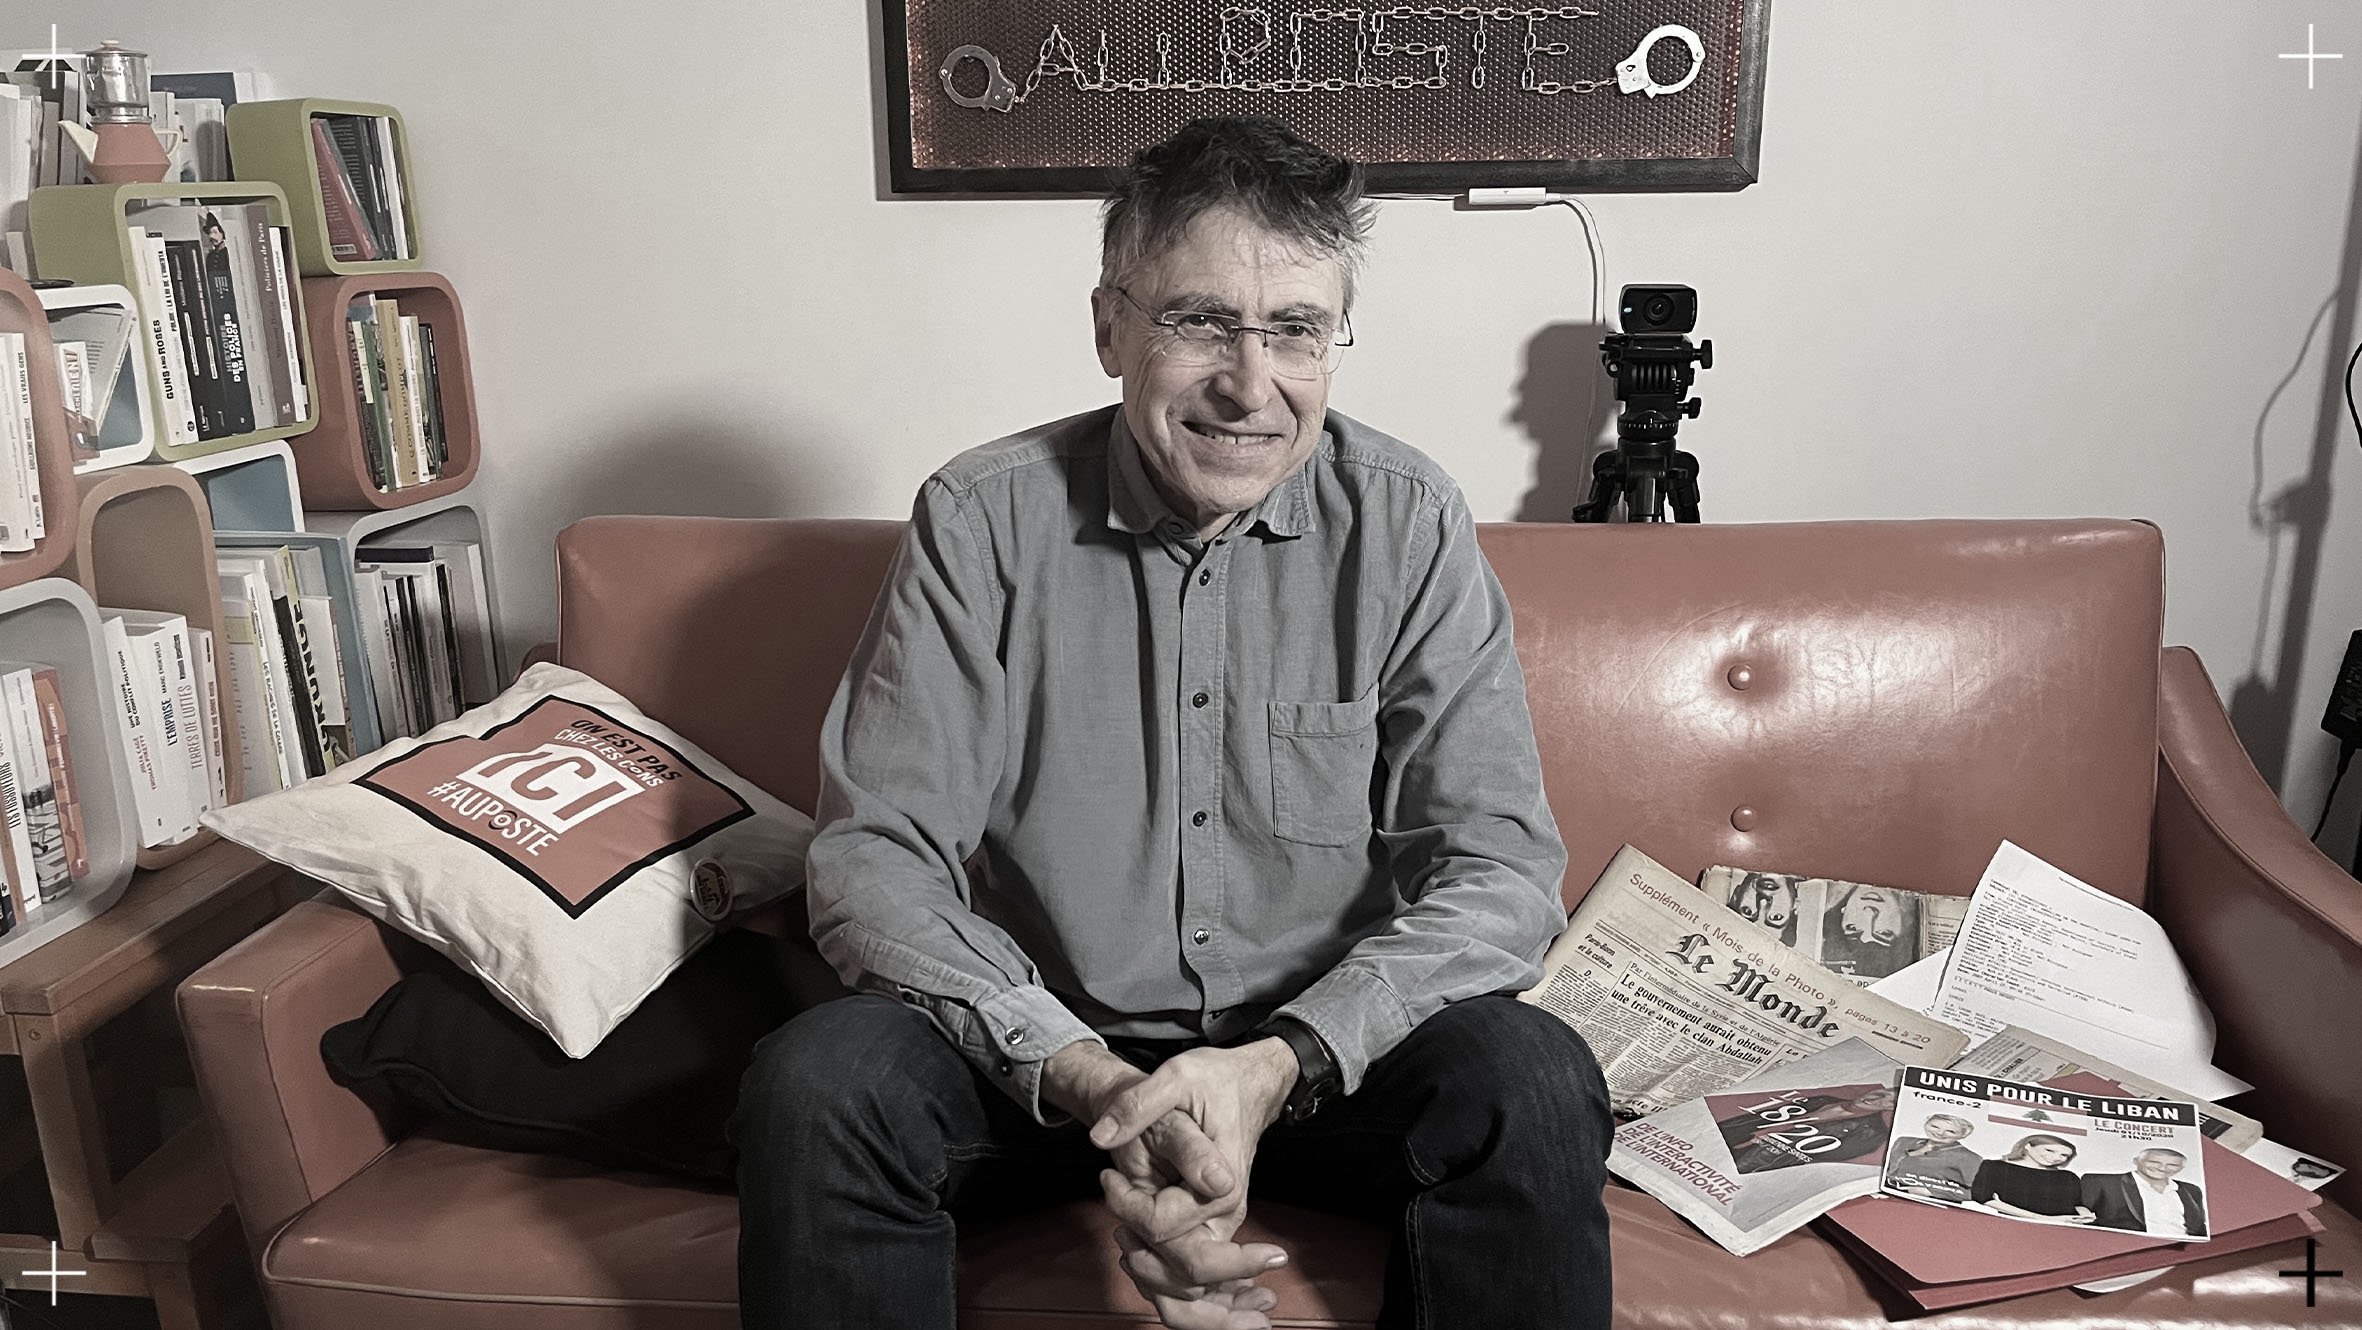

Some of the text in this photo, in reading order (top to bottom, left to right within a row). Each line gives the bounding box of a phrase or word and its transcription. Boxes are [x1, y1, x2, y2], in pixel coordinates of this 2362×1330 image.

[258, 222, 272, 292] Policiers de Paris
[17, 351, 25, 369] GENS
[153, 319, 166, 355] ROSES
[223, 312, 242, 383] DES POLICES
[231, 322, 245, 371] EN FRANCE
[19, 369, 28, 392] VRAIES
[164, 370, 174, 400] GUNS
[116, 650, 141, 725] DU CONFLIT POLITIQUE
[119, 683, 133, 713] HISTOIRE
[178, 684, 197, 718] LUTTES
[293, 600, 330, 753] GRUNGE
[161, 697, 178, 747] L'EMPRISE
[185, 720, 198, 734] DE
[553, 728, 598, 746] CHEZ
[591, 741, 624, 762] LES
[137, 734, 158, 790] THOMAS PIKETTY
[186, 733, 203, 770] TERRES
[571, 719, 683, 782] ON EST PAS
[477, 751, 628, 822] ICI
[1630, 873, 1700, 924] Supplément
[1712, 927, 1744, 952] Mois
[1747, 951, 1763, 966] de
[1768, 963, 1780, 977] la
[1784, 973, 1825, 1000] Photo
[1844, 1008, 1878, 1025] pages
[1884, 1023, 1898, 1033] 13
[1912, 1034, 1931, 1044] 20
[1630, 962, 1642, 974] Par
[1692, 1001, 1701, 1009] de
[1711, 1009, 1728, 1023] Syrie
[1665, 933, 1714, 974] Le
[1714, 959, 1840, 1038] Monde
[1611, 989, 1762, 1066] une trêve avec le clan Abdallah
[1621, 974, 1771, 1056] Le gouvernement aurait obtenu
[1779, 1090, 1809, 1104] Le
[1919, 1071, 2179, 1121] UNIS POUR LE LIBAN
[1637, 1122, 1694, 1151] DE L'INFO
[1738, 1097, 1842, 1154] 18/20
[2094, 1119, 2174, 1133] LE CONCERT
[1622, 1127, 1743, 1194] DE L'INTERACTIVITÉ
[1625, 1141, 1732, 1206] L'INTERNATIONAL
